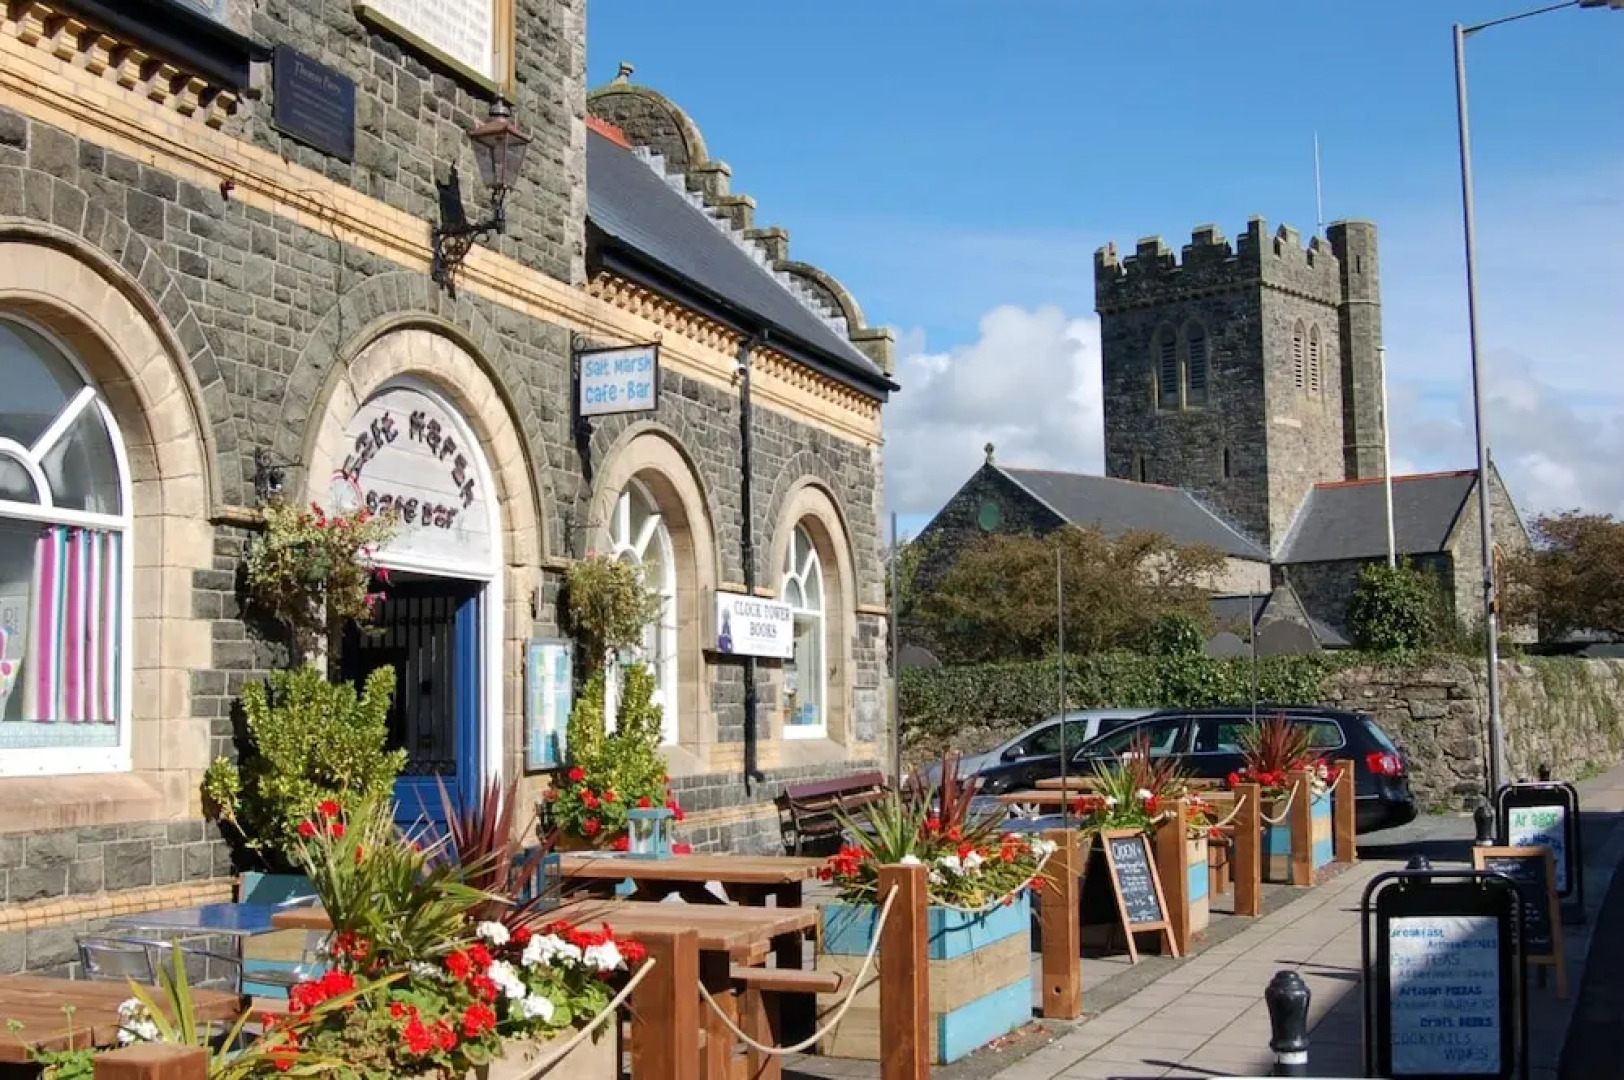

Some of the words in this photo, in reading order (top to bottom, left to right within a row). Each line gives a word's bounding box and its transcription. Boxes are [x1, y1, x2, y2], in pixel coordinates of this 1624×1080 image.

[585, 357, 611, 377] Salt
[613, 353, 652, 375] Marsh
[733, 600, 762, 618] CLOCK
[764, 604, 790, 622] TOWER
[749, 621, 777, 638] BOOKS
